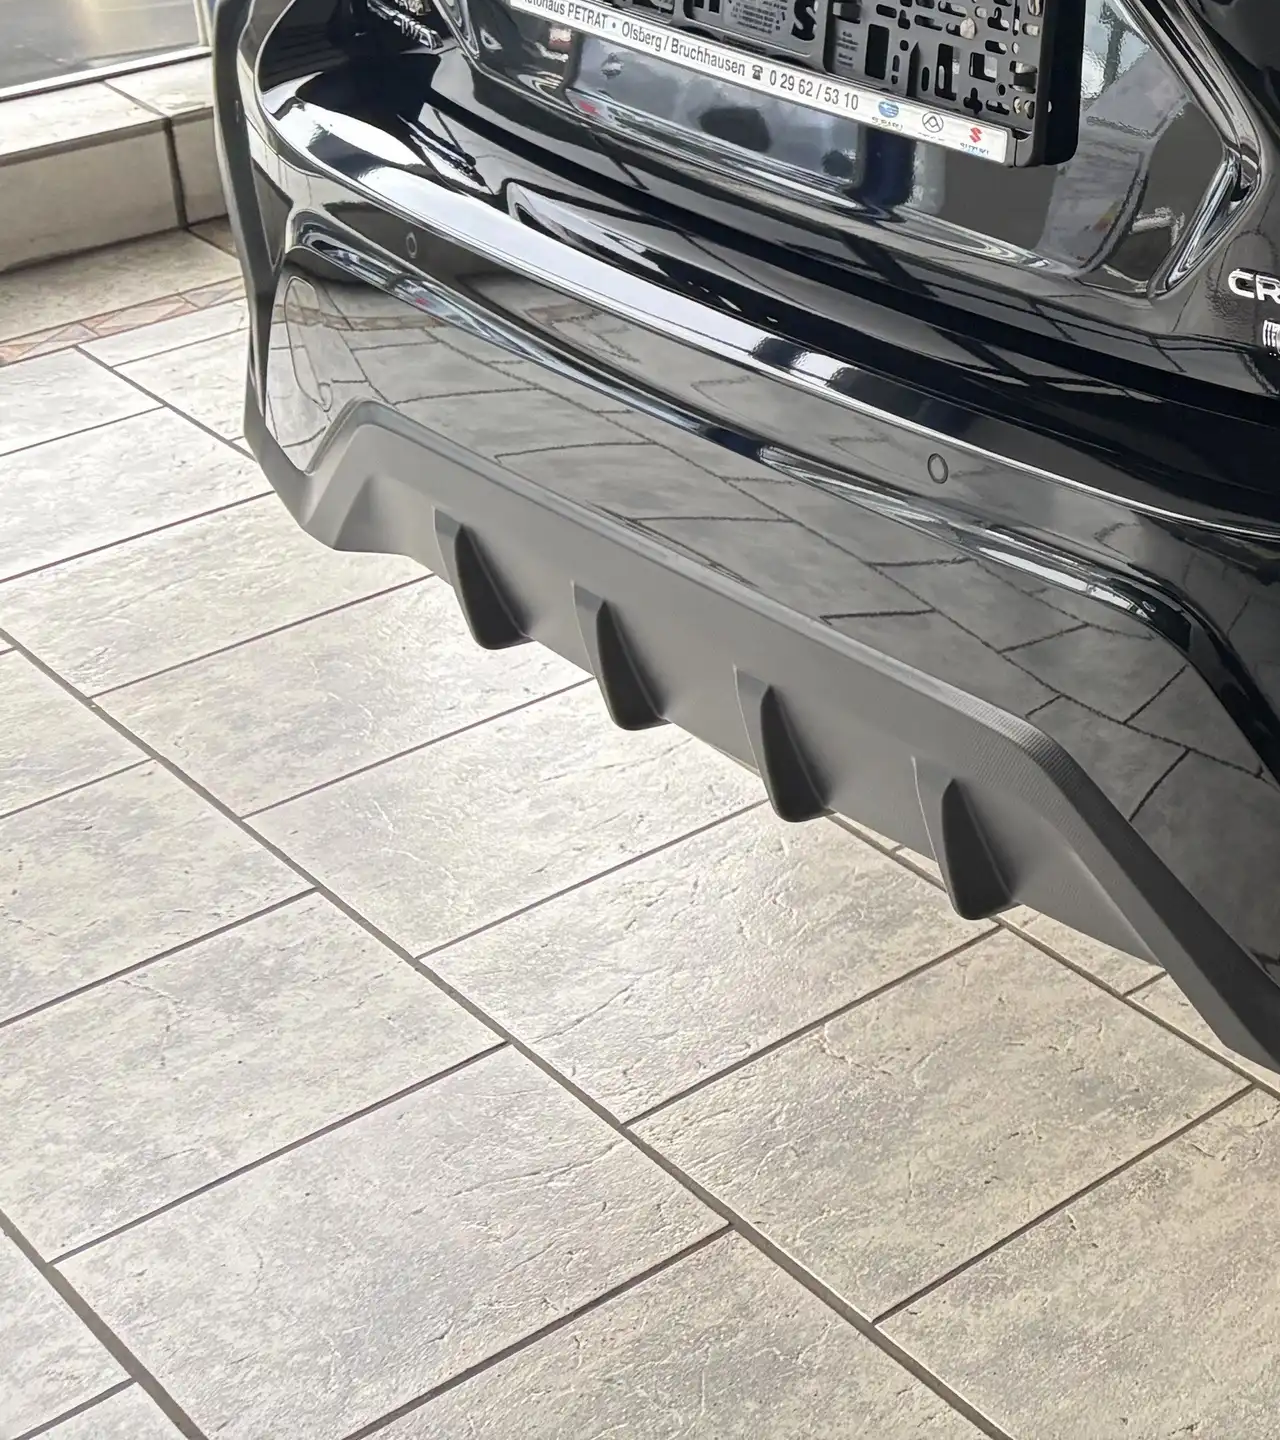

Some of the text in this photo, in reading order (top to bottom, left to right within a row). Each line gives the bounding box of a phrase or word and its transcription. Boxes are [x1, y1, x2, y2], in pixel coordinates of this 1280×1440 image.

[567, 2, 609, 29] PETRAT
[622, 21, 663, 52] Olsberg
[671, 38, 745, 76] Bruchhausen
[769, 70, 777, 86] 0
[780, 73, 795, 91] 29
[798, 79, 813, 98] 62
[825, 86, 839, 105] 53
[844, 92, 859, 111] 10
